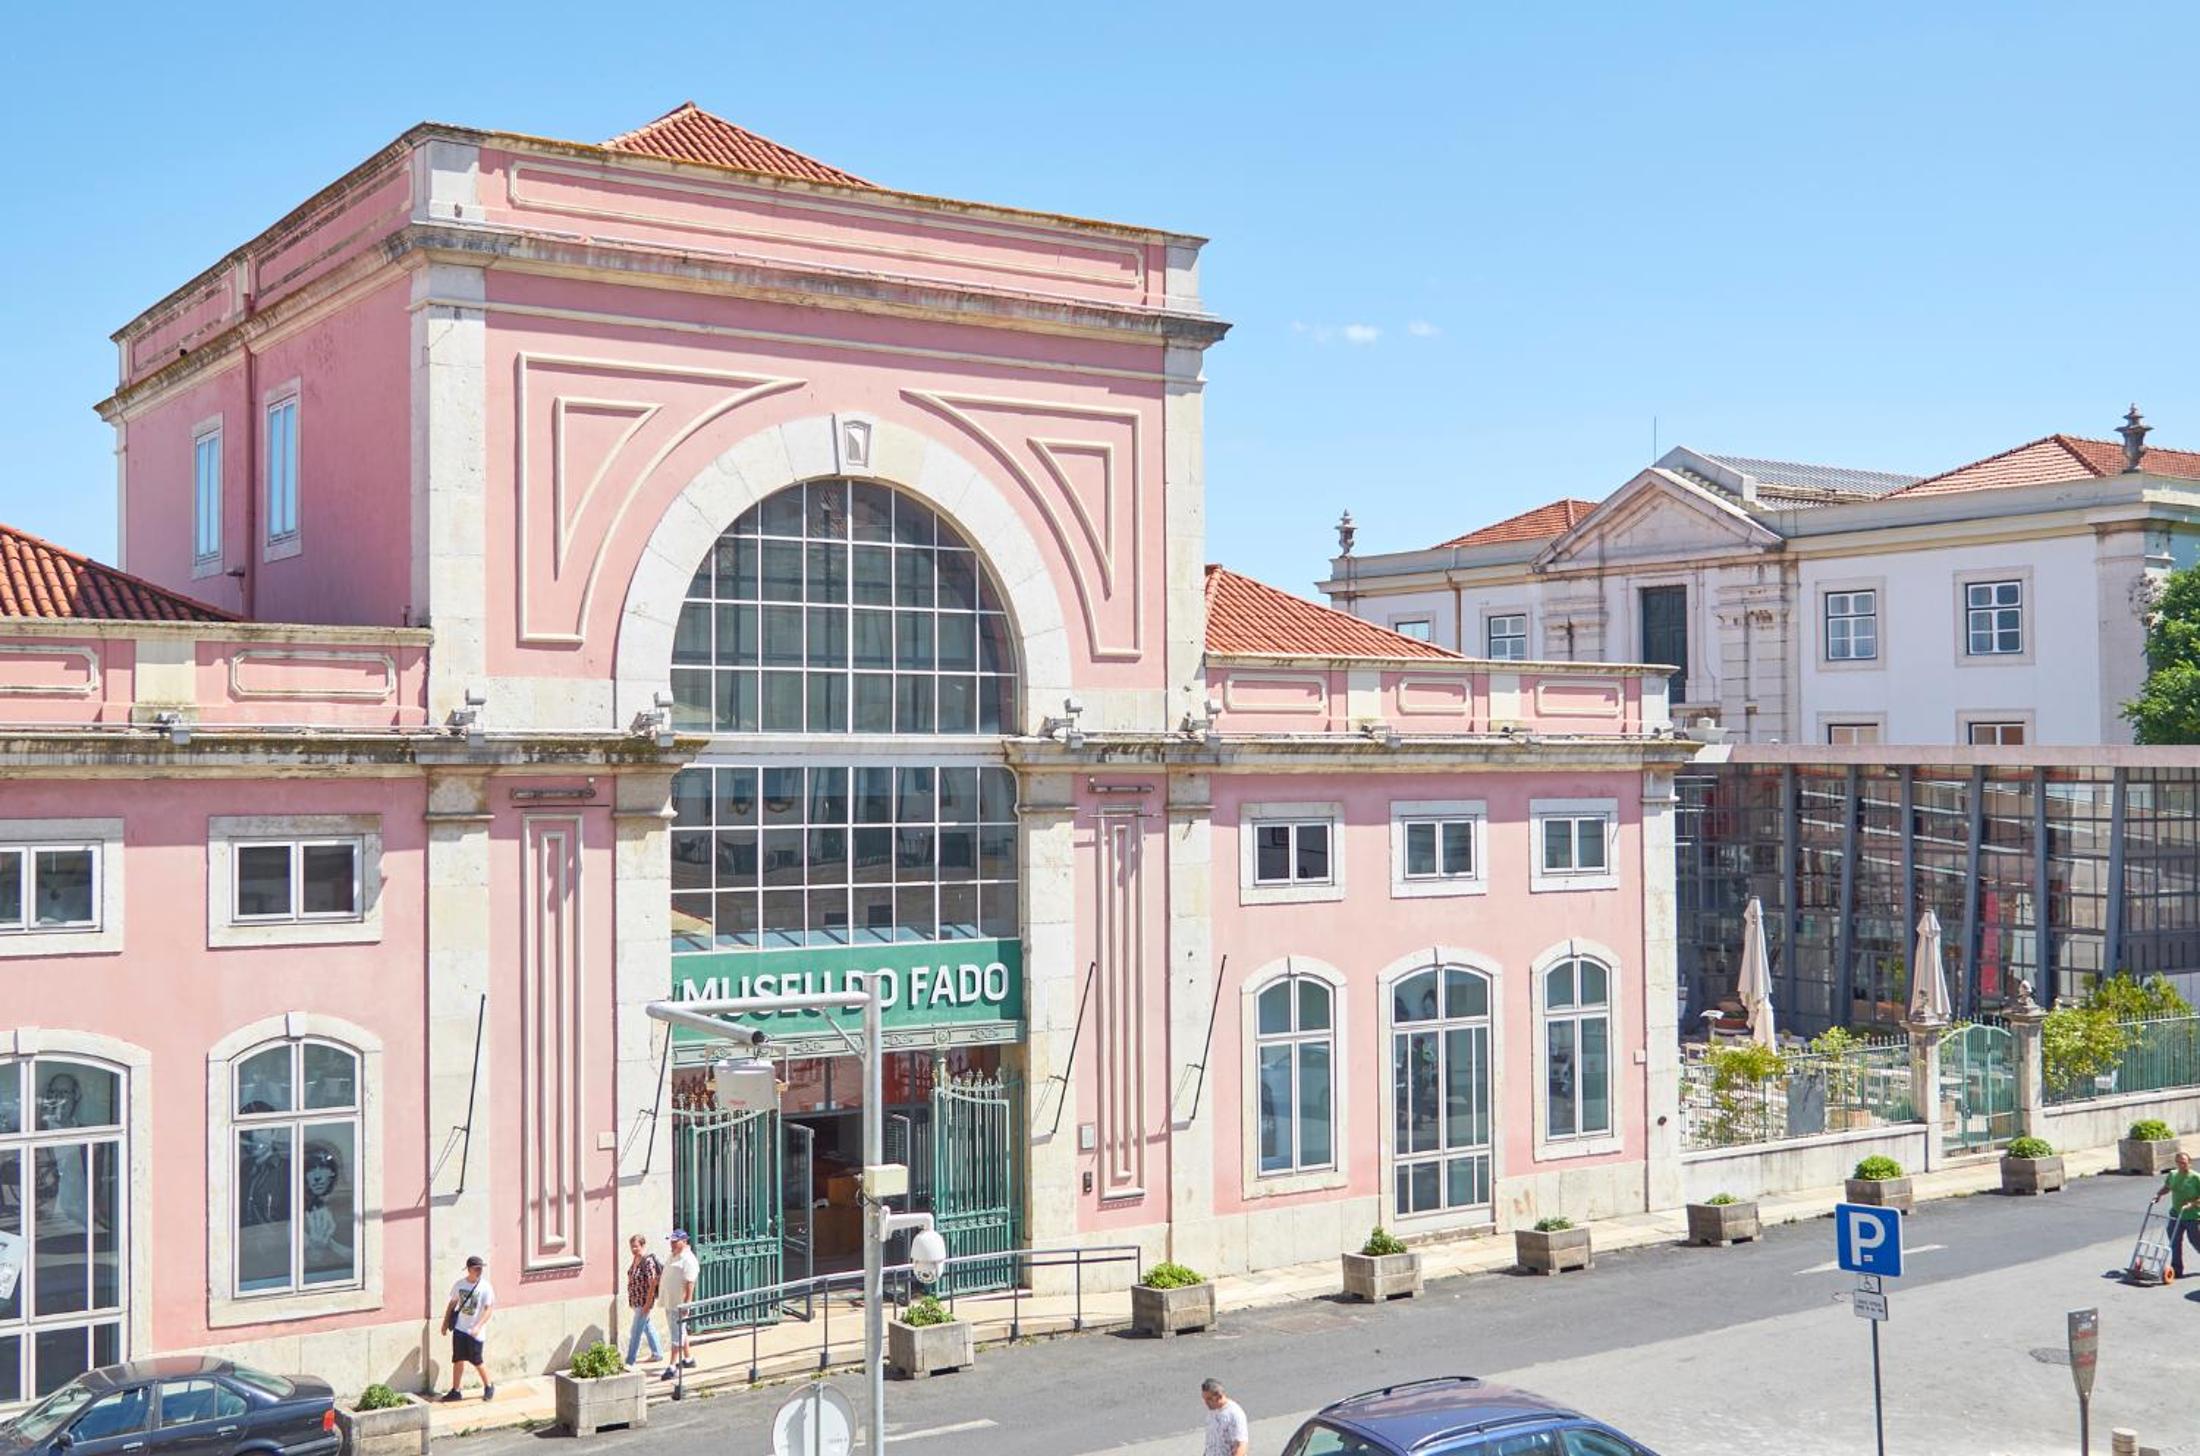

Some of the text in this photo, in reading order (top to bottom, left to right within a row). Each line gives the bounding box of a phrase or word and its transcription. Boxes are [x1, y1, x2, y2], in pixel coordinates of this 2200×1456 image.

[682, 962, 1009, 1018] MUSEU DO FADO
[1849, 1212, 1885, 1266] P
